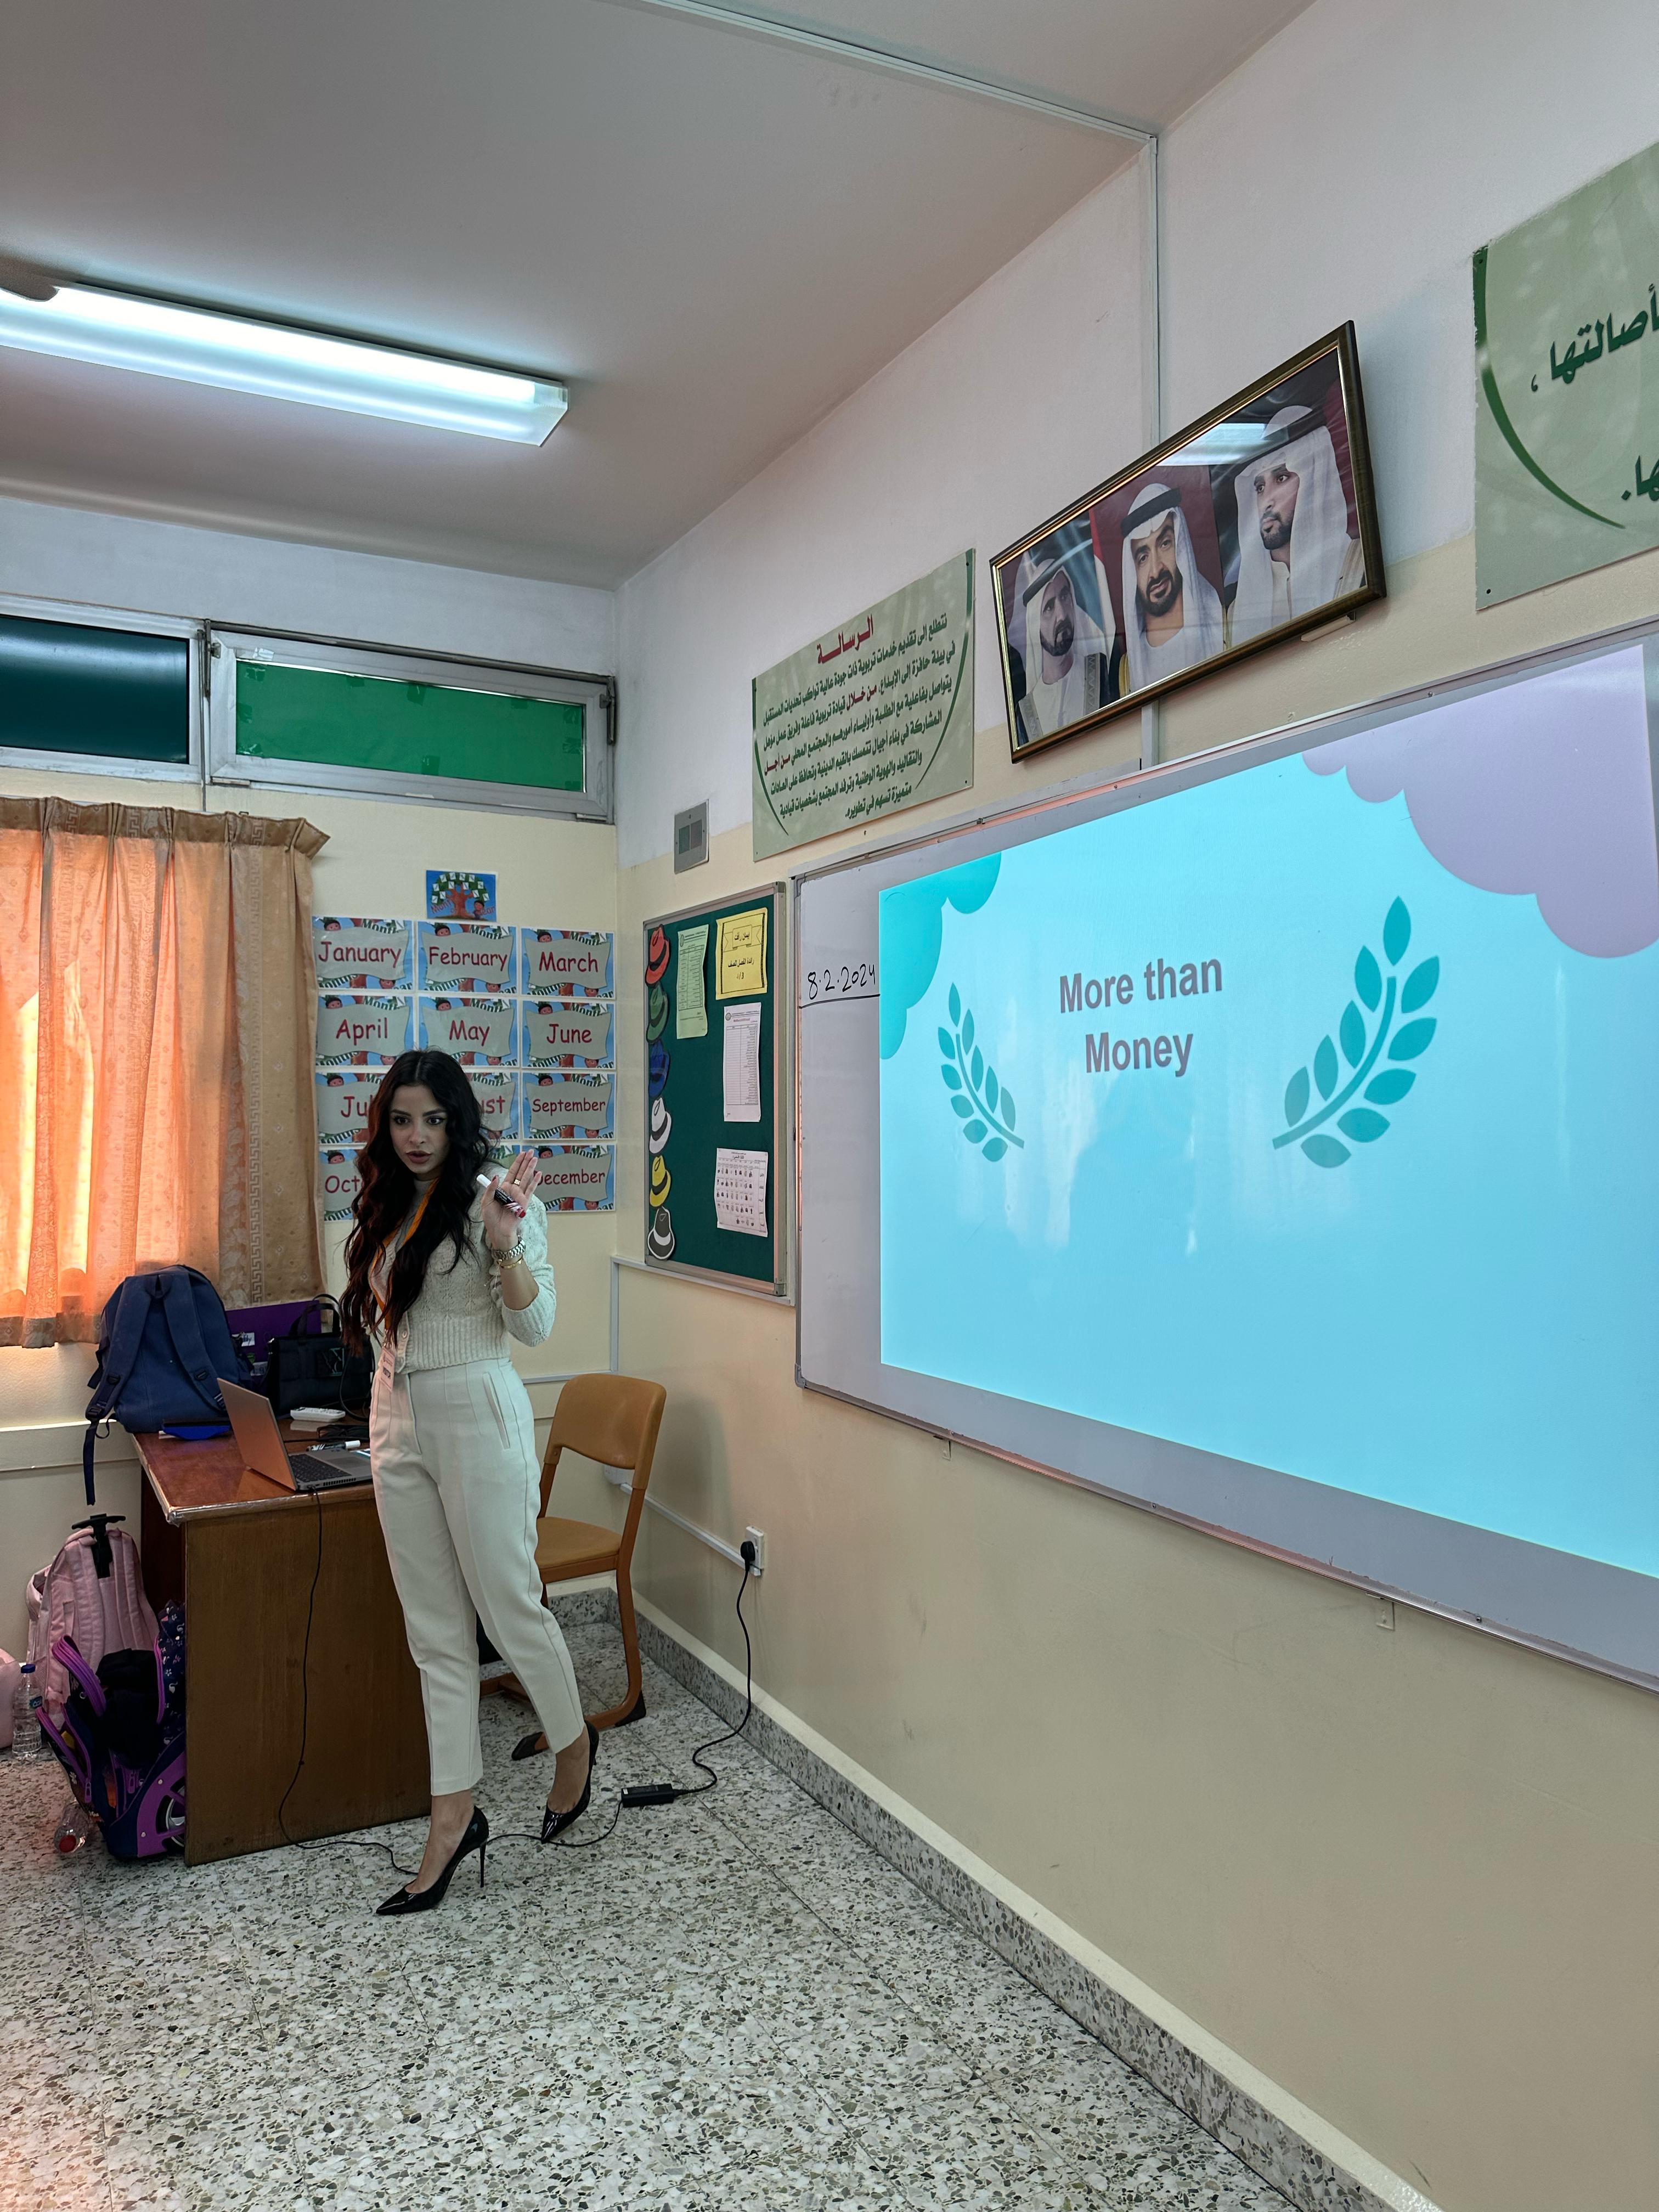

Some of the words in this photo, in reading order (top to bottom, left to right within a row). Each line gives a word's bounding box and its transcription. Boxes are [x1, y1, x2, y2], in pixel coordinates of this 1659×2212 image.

[929, 613, 947, 641] نتطلع
[877, 641, 896, 663] خدمات
[899, 630, 916, 656] تقديم
[946, 640, 955, 664] في
[858, 652, 876, 675] تربوية
[932, 650, 945, 665] بيئة
[834, 672, 847, 687] جودة
[848, 661, 857, 679] ذات
[803, 682, 819, 706] تواكب
[820, 677, 833, 696] عالية
[867, 685, 877, 702] من
[929, 674, 951, 701] يتواصل
[785, 692, 802, 713] تحديات
[832, 695, 845, 715] قيادة
[847, 686, 865, 711] خلال
[905, 686, 928, 710] بفاعلية
[764, 702, 783, 727] المستقبل
[801, 712, 815, 729] فاعلة
[816, 703, 831, 725] تربوية
[875, 701, 895, 724] الطلبة
[896, 701, 904, 718] مع
[787, 720, 800, 741] وفريق
[910, 709, 941, 734] المشاركة
[776, 730, 786, 746] عمل
[808, 732, 831, 758] والمجتمع
[889, 729, 900, 746] بناء
[901, 723, 909, 746] في
[792, 742, 806, 766] المحلي
[836, 751, 851, 771] بالقيم
[852, 740, 871, 760] تتمسك
[897, 749, 922, 772] والتقاليد
[781, 754, 790, 769] من
[817, 757, 834, 777] الدينية
[876, 759, 895, 781] والهوية
[771, 777, 788, 795] العادات
[789, 774, 798, 791] على
[855, 767, 875, 789] الوطنية
[819, 782, 838, 806] المجتمع
[875, 788, 890, 810] تسهم
[891, 782, 911, 803] متميزة
[780, 799, 794, 819] قيادية
[866, 794, 874, 815] في
[318, 941, 402, 968] January
[429, 946, 507, 972] February
[539, 951, 598, 973] March
[1060, 973, 1133, 1013] More
[1144, 958, 1222, 1001] than
[336, 1017, 388, 1046] April
[449, 1020, 490, 1047] May
[546, 1024, 592, 1044] June
[1085, 1032, 1194, 1077] Money
[532, 1098, 606, 1116] September
